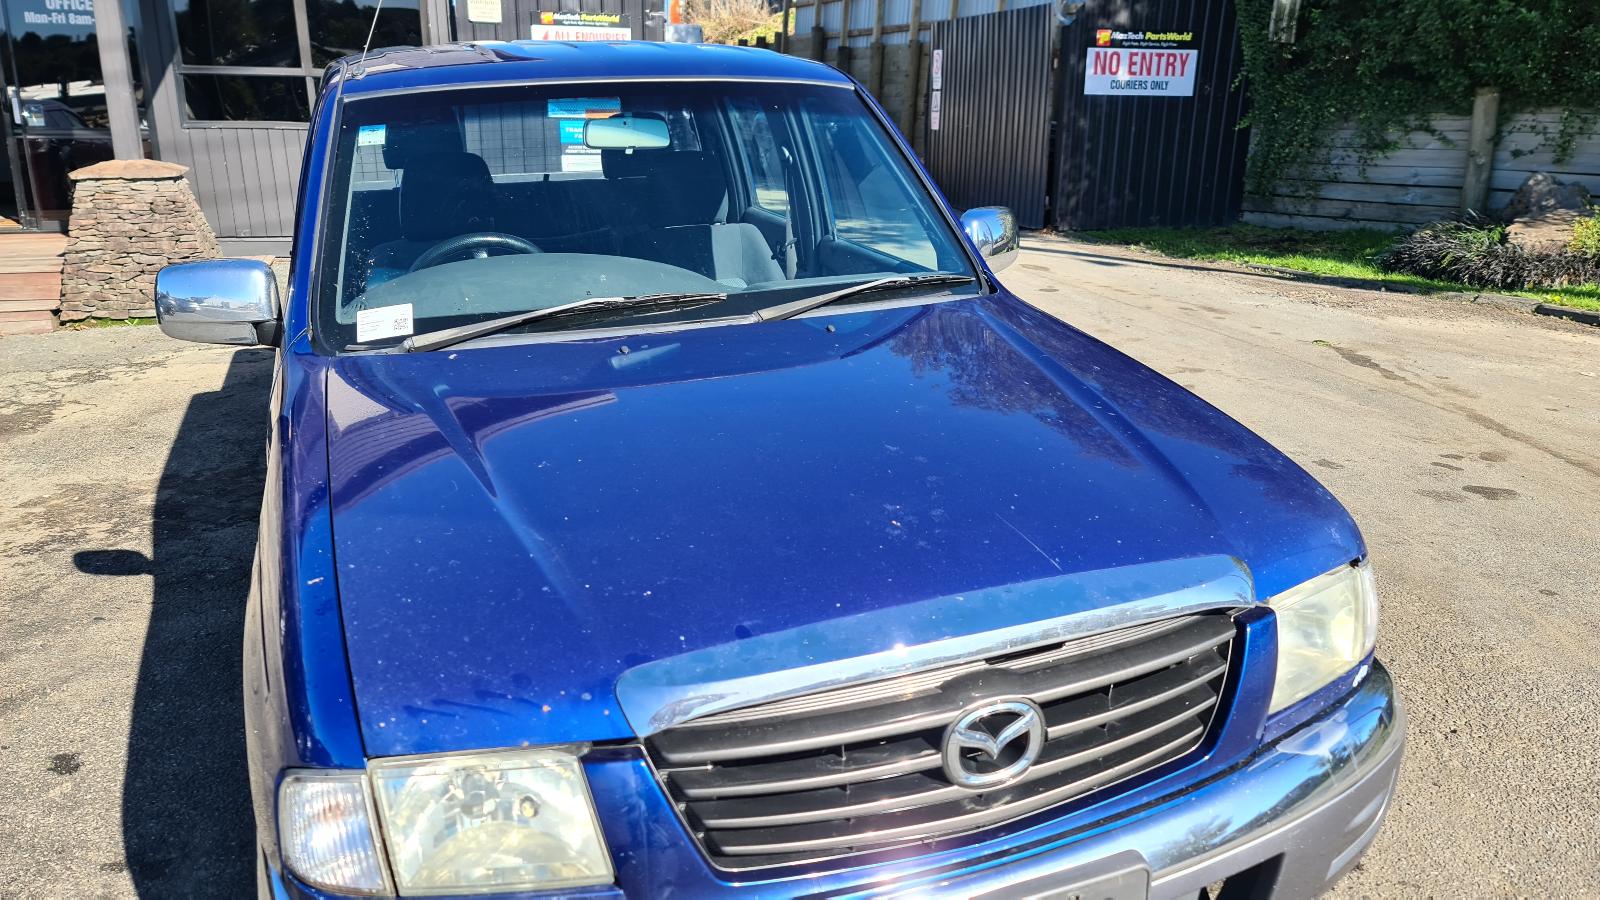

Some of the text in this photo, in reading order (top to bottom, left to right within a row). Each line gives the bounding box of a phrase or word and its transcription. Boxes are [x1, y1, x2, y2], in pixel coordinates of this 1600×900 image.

[45, 0, 94, 11] OFFICE
[24, 11, 67, 24] Mon-Fri
[1145, 31, 1192, 41] PartsWorld
[1093, 50, 1190, 77] NO ENTRY
[1110, 80, 1169, 91] COURIERS ONLY
